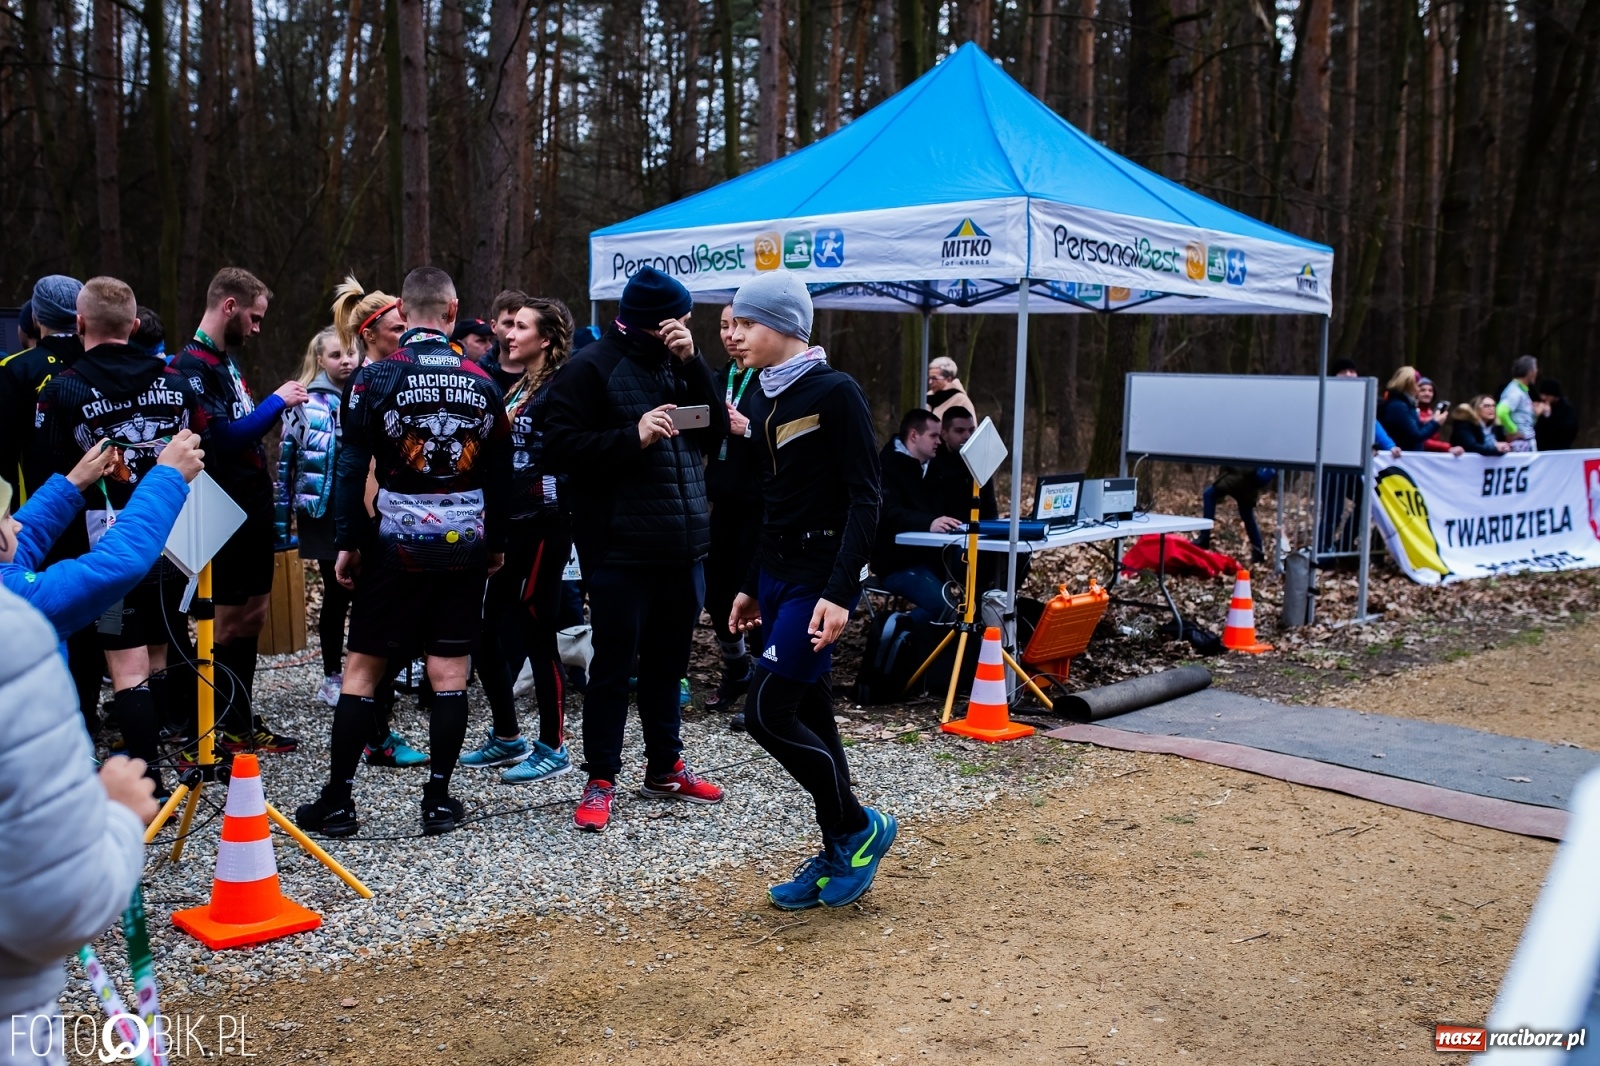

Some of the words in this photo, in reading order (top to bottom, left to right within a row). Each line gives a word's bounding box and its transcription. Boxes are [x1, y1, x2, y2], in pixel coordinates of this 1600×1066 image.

[941, 238, 992, 258] MITKO
[1054, 224, 1180, 273] PersonalBest
[959, 258, 990, 266] events
[396, 388, 440, 407] CROSS
[445, 388, 487, 409] GAMES
[1481, 465, 1530, 497] BIEG
[1444, 505, 1573, 548] TWARDZIELA
